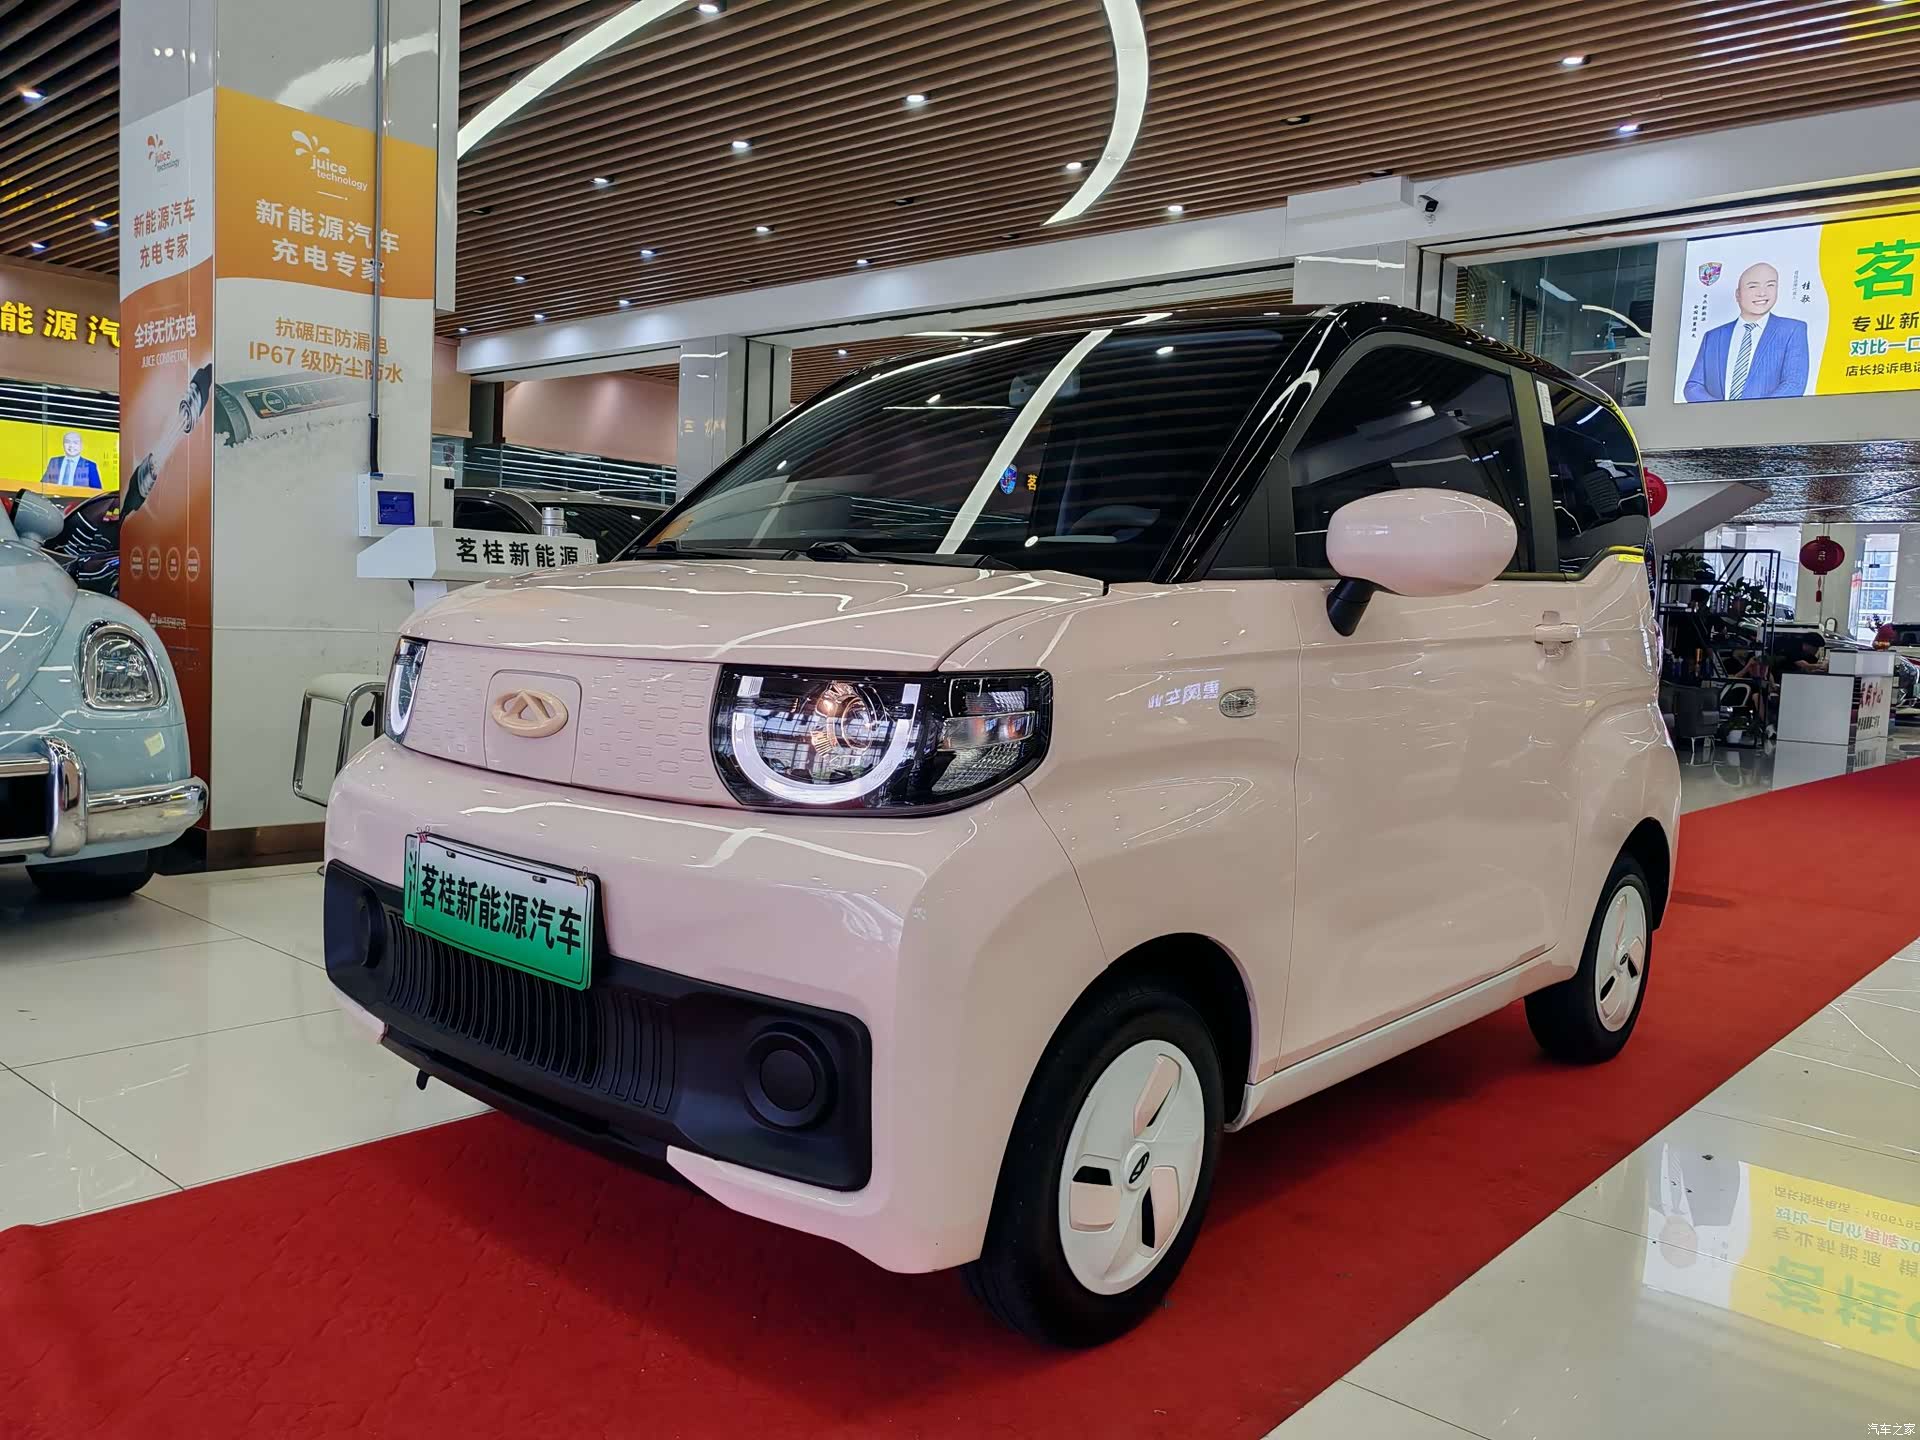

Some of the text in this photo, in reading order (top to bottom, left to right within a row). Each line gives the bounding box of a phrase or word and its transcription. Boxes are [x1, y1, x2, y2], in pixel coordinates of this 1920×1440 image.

[310, 155, 347, 175] juice
[317, 169, 368, 192] technology
[133, 197, 196, 239] 新能源汽车
[255, 199, 400, 254] 新能源汽车
[139, 233, 189, 269] 充电专家
[271, 237, 386, 283] 充电专家
[1854, 239, 1920, 300] 茗
[0, 301, 120, 348] 能源汽
[275, 316, 389, 355] 抗碾压防漏电
[1852, 311, 1920, 333] 专业新
[249, 341, 295, 366] IP67
[455, 537, 579, 567] 茗桂新能源
[420, 862, 582, 956] 茗桂新能源汽车
